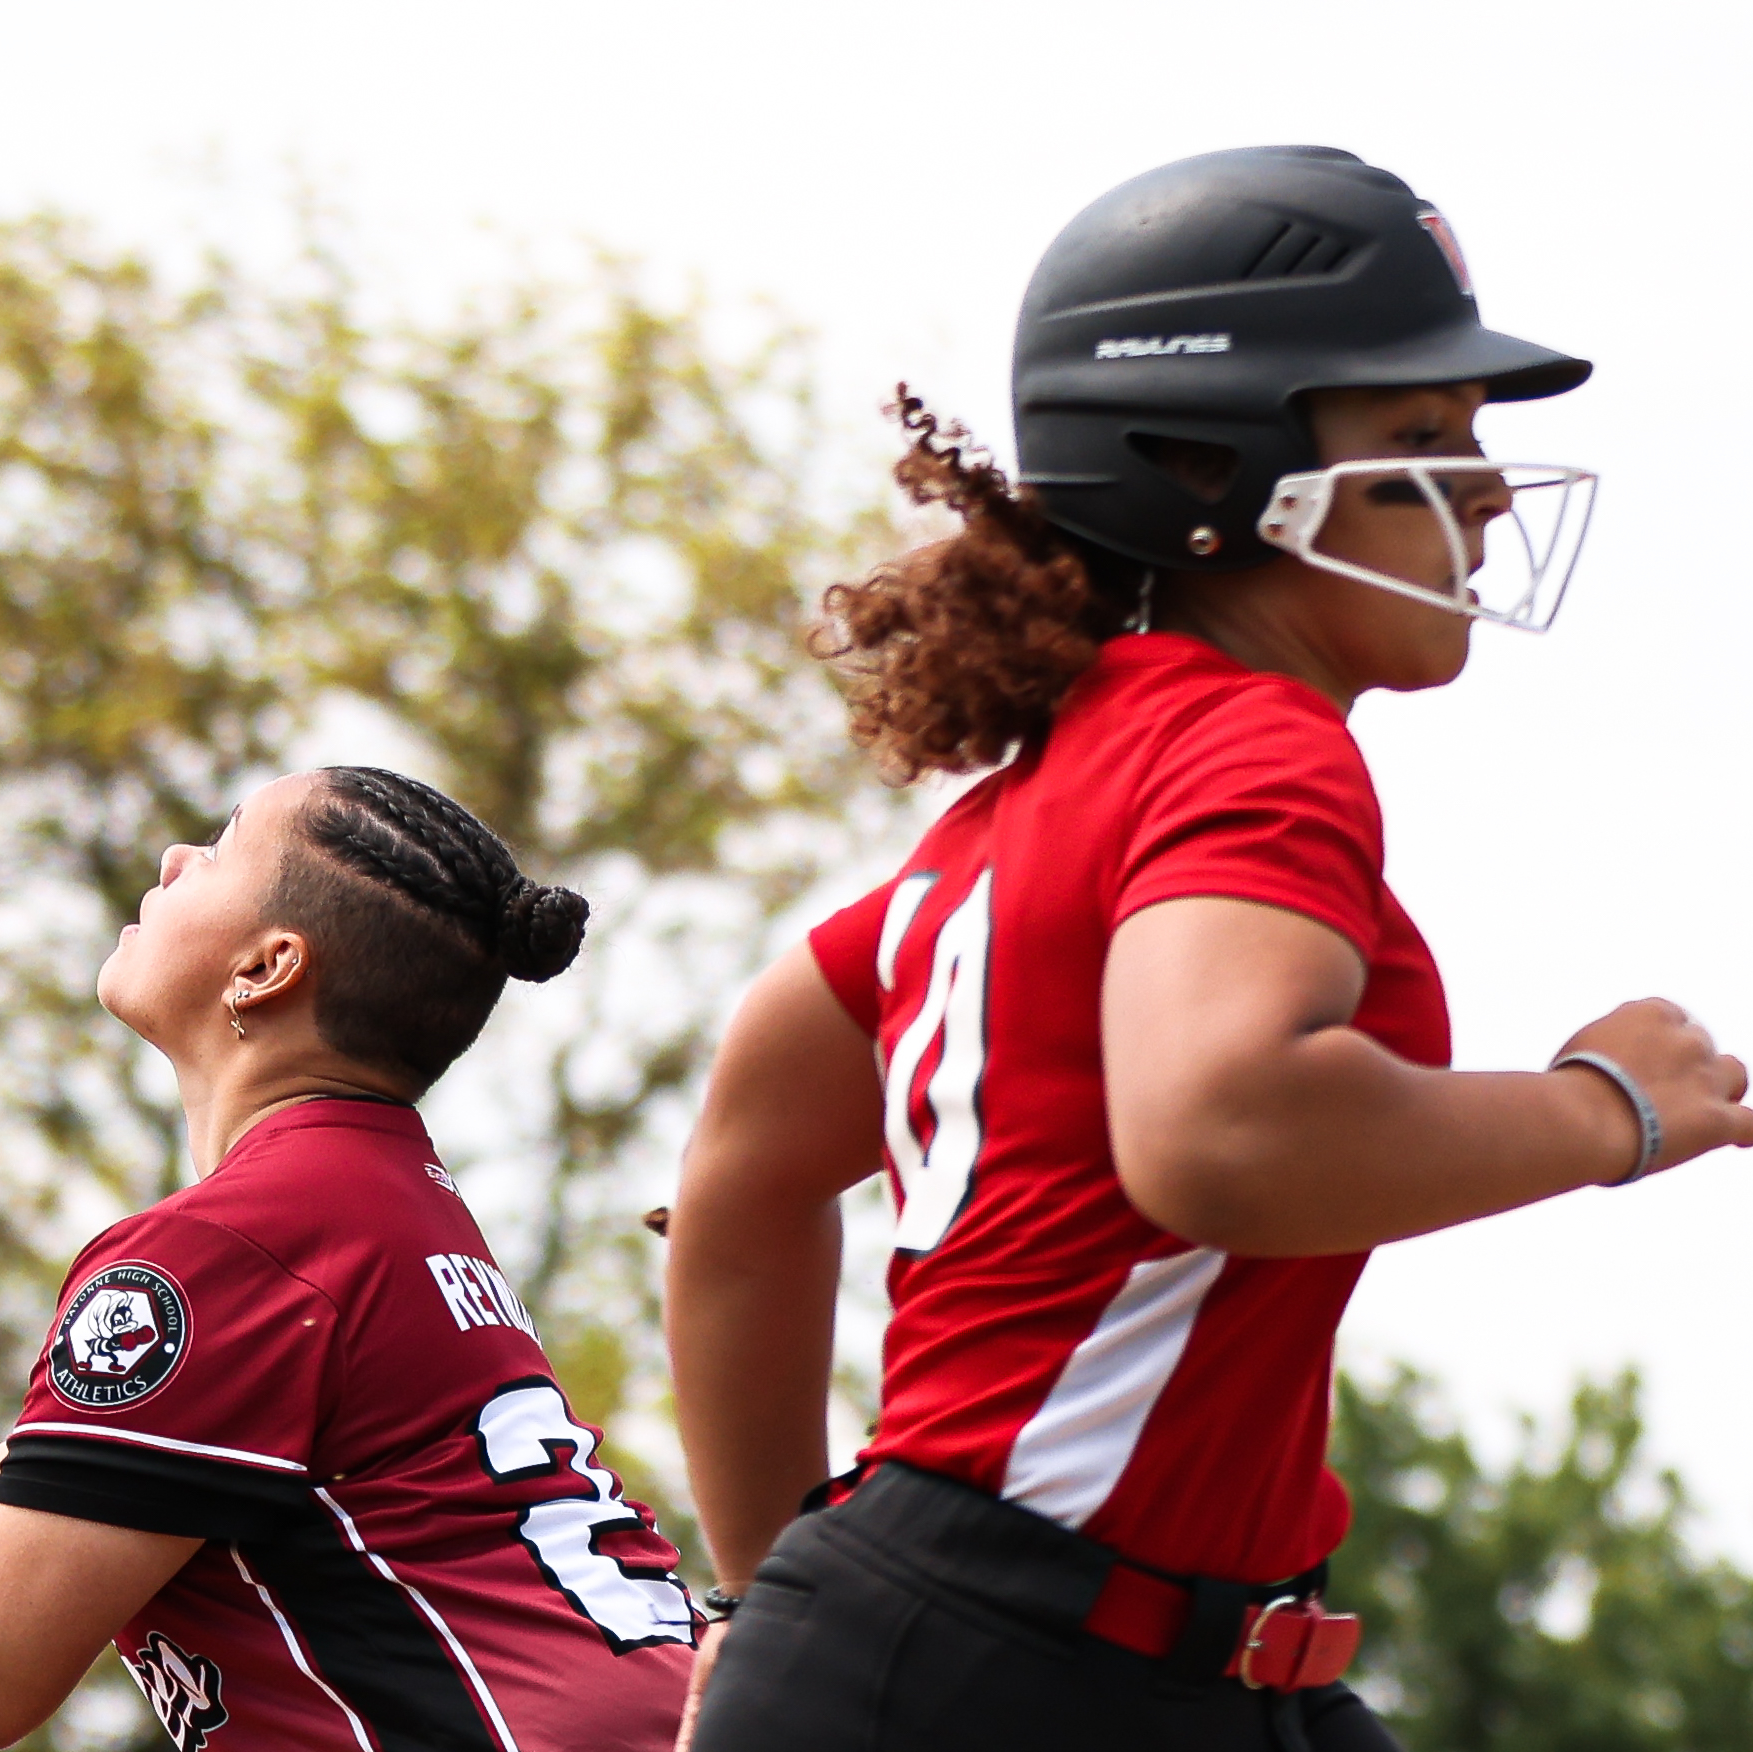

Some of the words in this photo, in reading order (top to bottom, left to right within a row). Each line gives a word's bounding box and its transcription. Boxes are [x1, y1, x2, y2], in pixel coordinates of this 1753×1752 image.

[64, 1274, 111, 1326] BAYONNE
[117, 1270, 151, 1285] HIGH
[151, 1282, 178, 1334] SCHOOL
[56, 1368, 148, 1402] ATHLETICS
